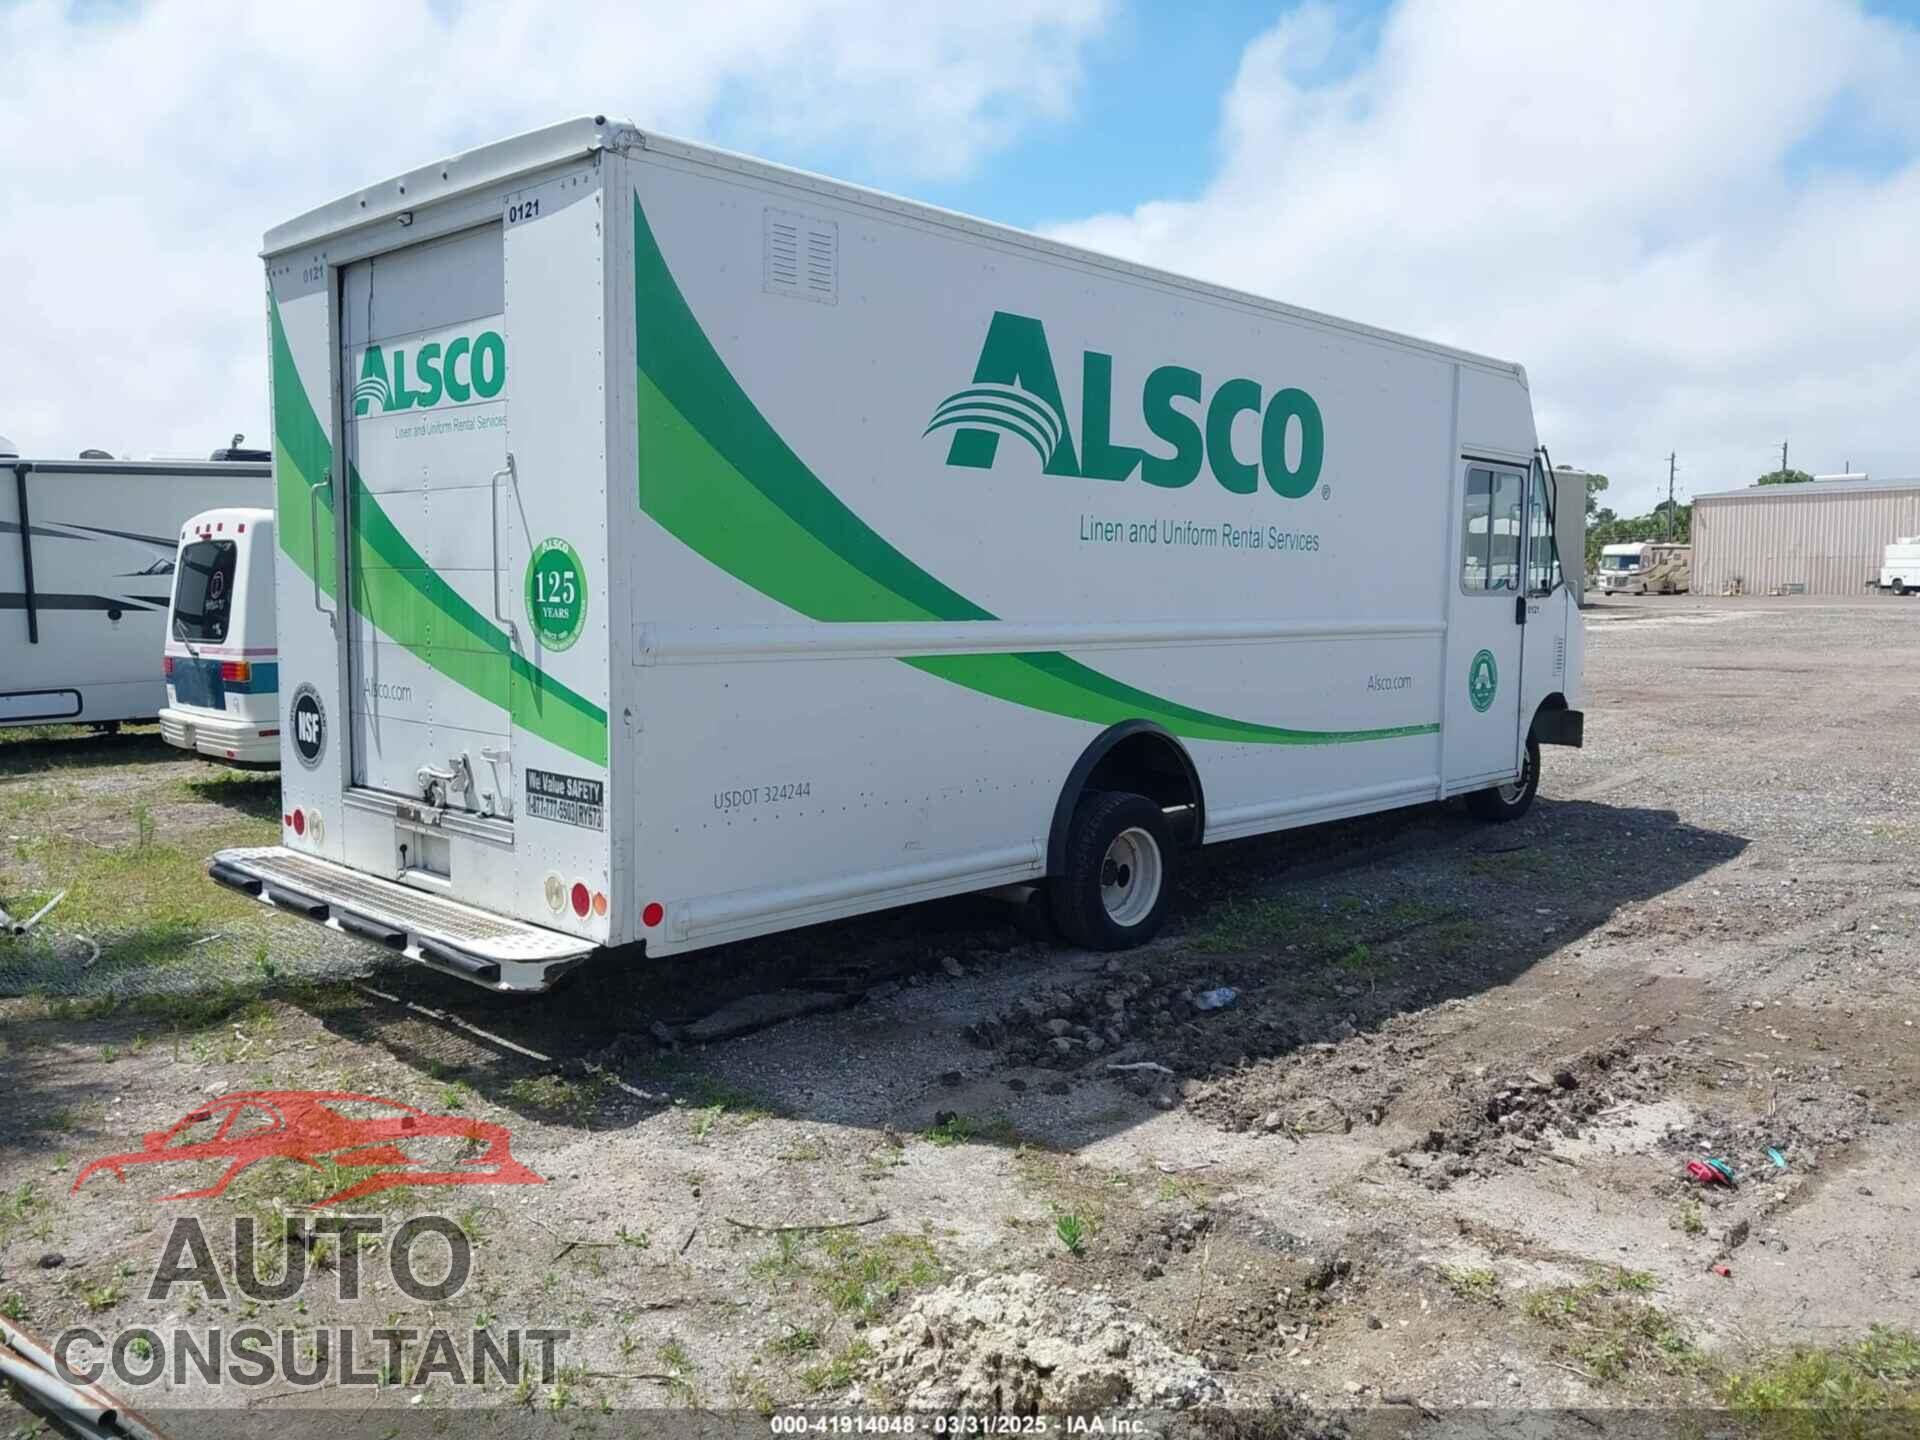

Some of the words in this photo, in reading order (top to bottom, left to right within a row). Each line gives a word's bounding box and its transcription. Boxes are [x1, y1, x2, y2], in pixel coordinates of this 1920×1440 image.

[509, 198, 539, 223] 0121
[303, 265, 324, 284] 0121
[352, 331, 506, 416] ALSCO
[922, 310, 1325, 500] ALSCO
[453, 417, 475, 432] Rental
[477, 414, 507, 430] Services
[1080, 513, 1123, 542] Linen
[1129, 519, 1157, 544] and
[1162, 520, 1217, 546] Uniform
[1222, 523, 1263, 550] Rental
[1267, 526, 1320, 552] Services
[542, 539, 569, 553] ALSCO
[535, 570, 575, 604] 125
[542, 607, 569, 619] YEARS
[363, 679, 413, 702] Alsco.com
[1367, 674, 1412, 691] Alsco.com
[298, 711, 320, 743] NSF
[528, 771, 541, 790] We
[542, 772, 566, 795] Value
[566, 778, 600, 801] SAFETY
[714, 788, 759, 809] USDOT
[765, 782, 811, 803] 324244
